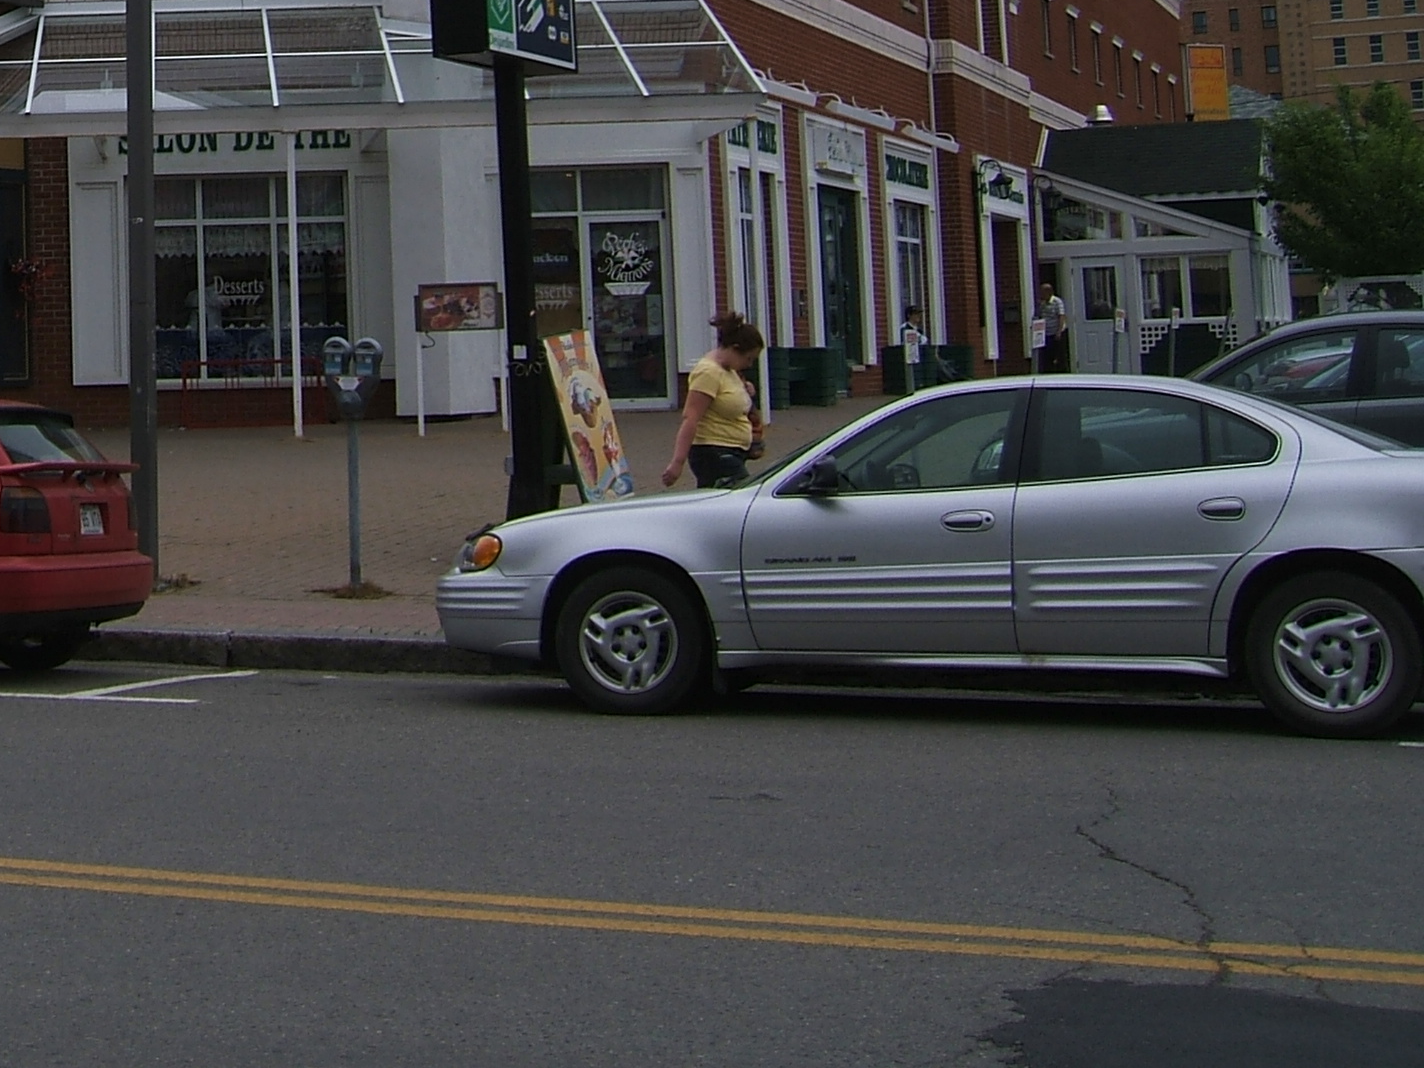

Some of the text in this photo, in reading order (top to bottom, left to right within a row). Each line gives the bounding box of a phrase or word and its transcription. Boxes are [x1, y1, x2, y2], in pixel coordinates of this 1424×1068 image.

[118, 131, 218, 155] LON
[232, 131, 275, 152] DE
[213, 275, 265, 295] Desserts
[533, 283, 575, 300] sserts
